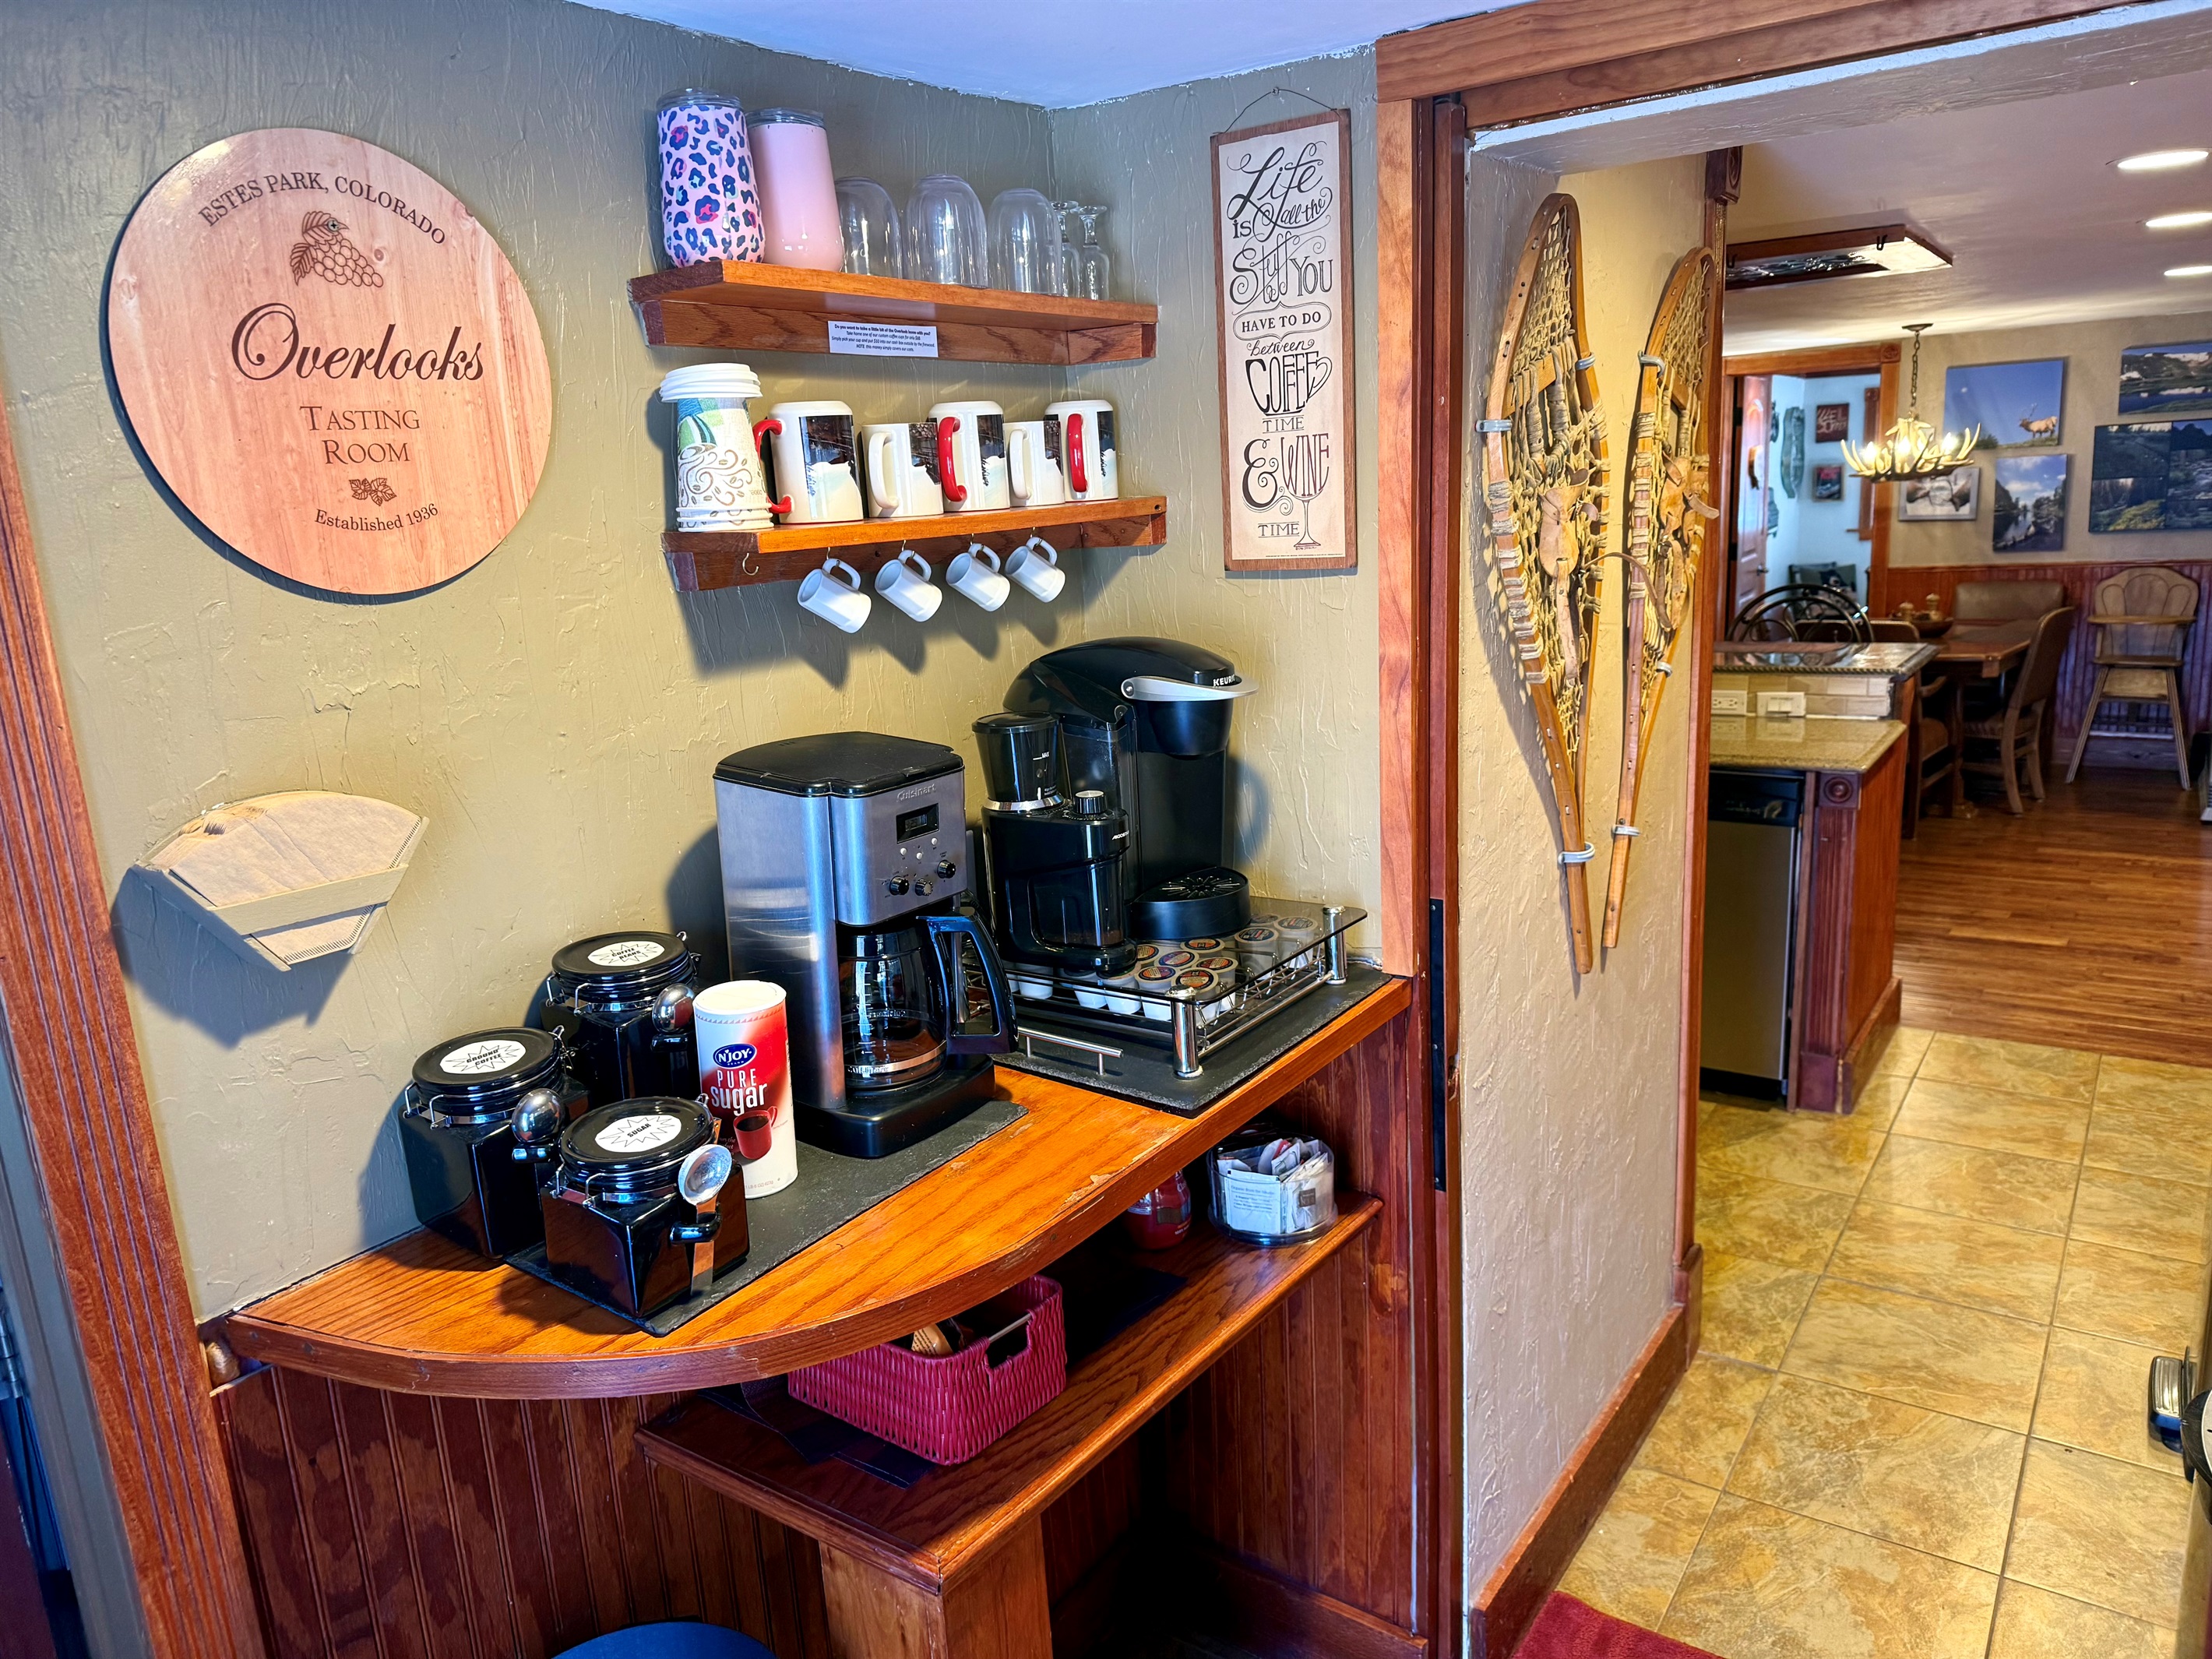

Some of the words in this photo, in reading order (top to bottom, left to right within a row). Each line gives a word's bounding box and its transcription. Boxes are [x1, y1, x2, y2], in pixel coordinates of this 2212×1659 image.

[1227, 141, 1327, 242] Life
[198, 180, 263, 227] ESTES
[264, 172, 329, 193] PARK,
[335, 176, 446, 244] COLORADO
[1280, 206, 1301, 224] all
[1301, 196, 1326, 221] the
[1230, 231, 1296, 305] Stuff
[1289, 255, 1333, 297] YOU
[1241, 316, 1276, 333] HAVE
[1279, 314, 1298, 328] TO
[1301, 311, 1322, 326] DO
[233, 302, 484, 381] Overlooks
[1246, 339, 1315, 357] between
[1245, 350, 1324, 414] COFFEE
[300, 405, 421, 431] TASTING
[1262, 417, 1305, 433] TIME
[322, 439, 410, 465] ROOM
[1242, 438, 1280, 509] &
[1280, 433, 1330, 497] WINE
[315, 509, 404, 531] Established
[406, 503, 439, 526] 1936
[1258, 523, 1300, 537] TIME
[896, 784, 935, 802] Cuisinart
[611, 948, 635, 956] COFFEE
[467, 1049, 498, 1063] GROUND
[475, 1053, 501, 1065] COFFEE
[717, 1068, 757, 1089] PURE
[710, 1083, 768, 1117] sugar
[627, 1123, 651, 1137] SUGAR
